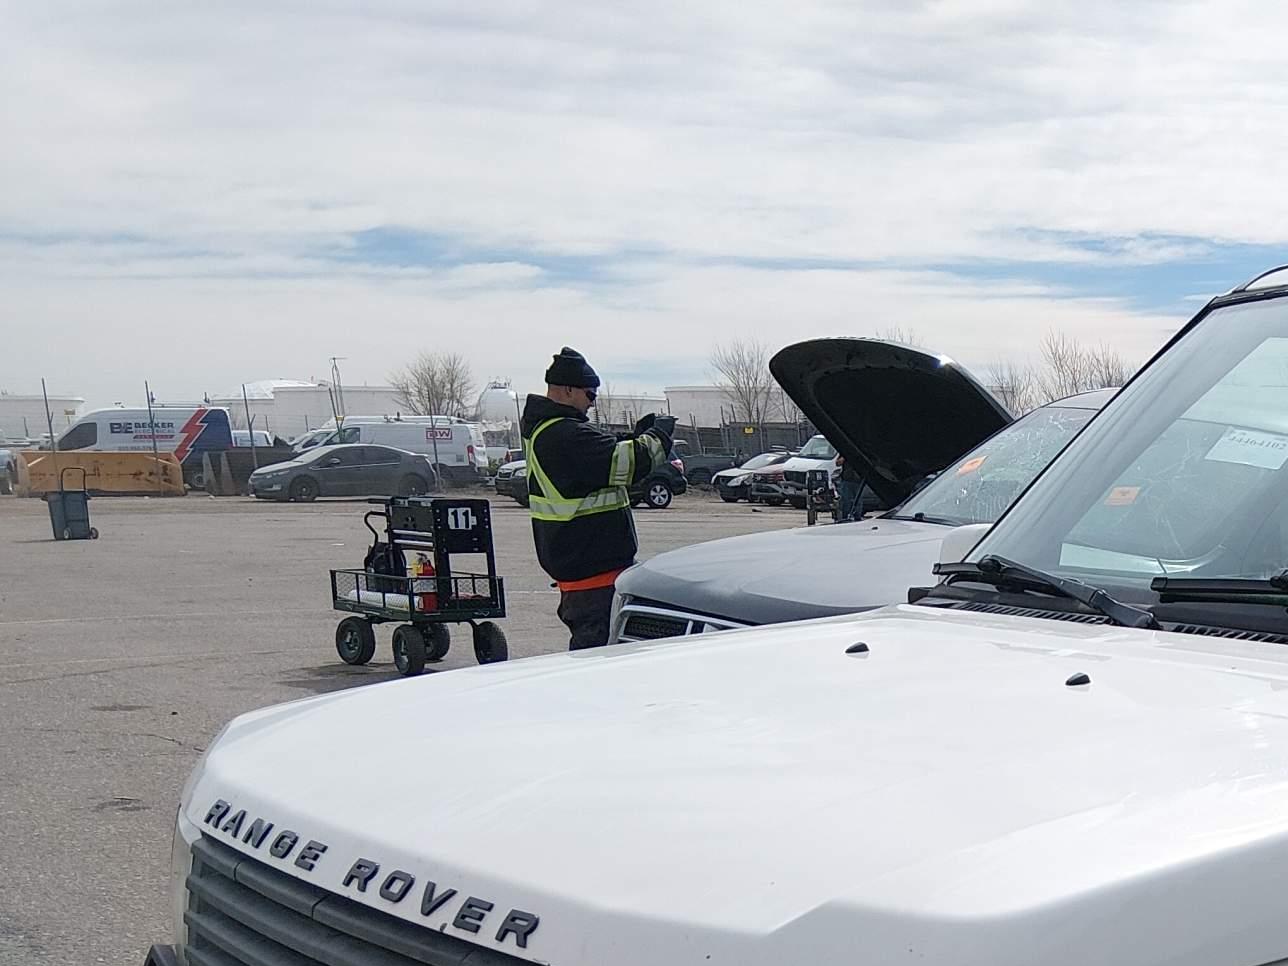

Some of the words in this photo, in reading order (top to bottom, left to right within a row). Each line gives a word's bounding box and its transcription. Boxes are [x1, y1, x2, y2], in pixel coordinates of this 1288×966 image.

[451, 509, 470, 529] 11
[203, 798, 328, 871] RANGE
[342, 857, 540, 948] ROVER
